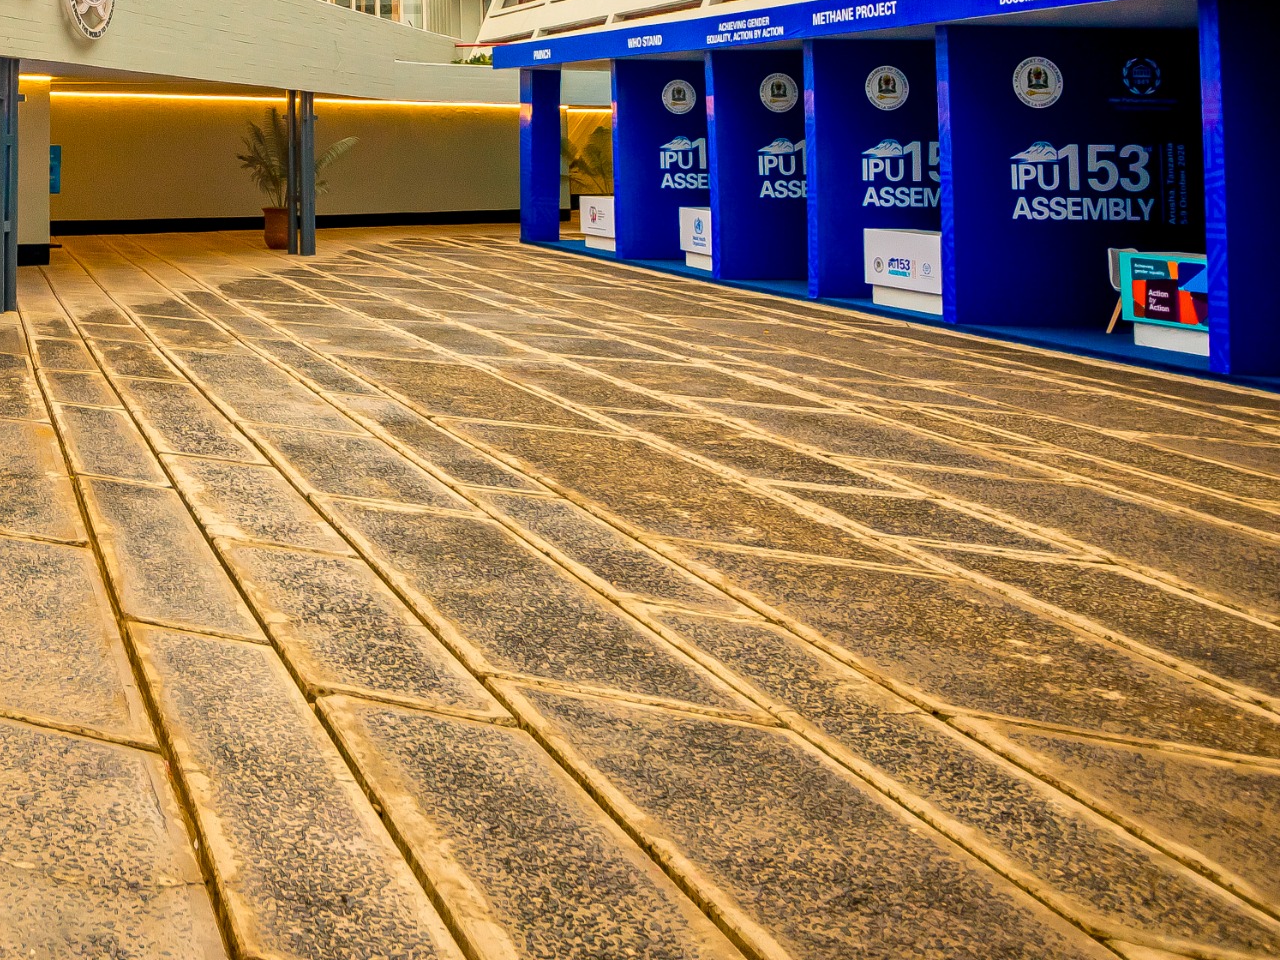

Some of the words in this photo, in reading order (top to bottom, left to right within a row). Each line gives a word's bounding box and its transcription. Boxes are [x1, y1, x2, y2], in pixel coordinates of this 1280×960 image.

[812, 7, 854, 26] METHANE
[855, 0, 897, 19] PROJECT
[718, 20, 746, 31] ACHIEVING
[747, 16, 770, 28] GENDER
[628, 36, 641, 49] WHO
[642, 34, 663, 48] STAND
[733, 30, 753, 41] ACTION
[753, 28, 761, 39] BY
[762, 26, 784, 37] ACTION
[660, 151, 693, 169] IPU
[758, 155, 796, 176] IPU
[862, 158, 905, 181] IPU
[1010, 163, 1060, 191] IPU
[1012, 196, 1155, 221] ASSEMBLY
[1148, 289, 1169, 298] Action
[1148, 296, 1157, 305] by
[1149, 303, 1170, 312] Action
